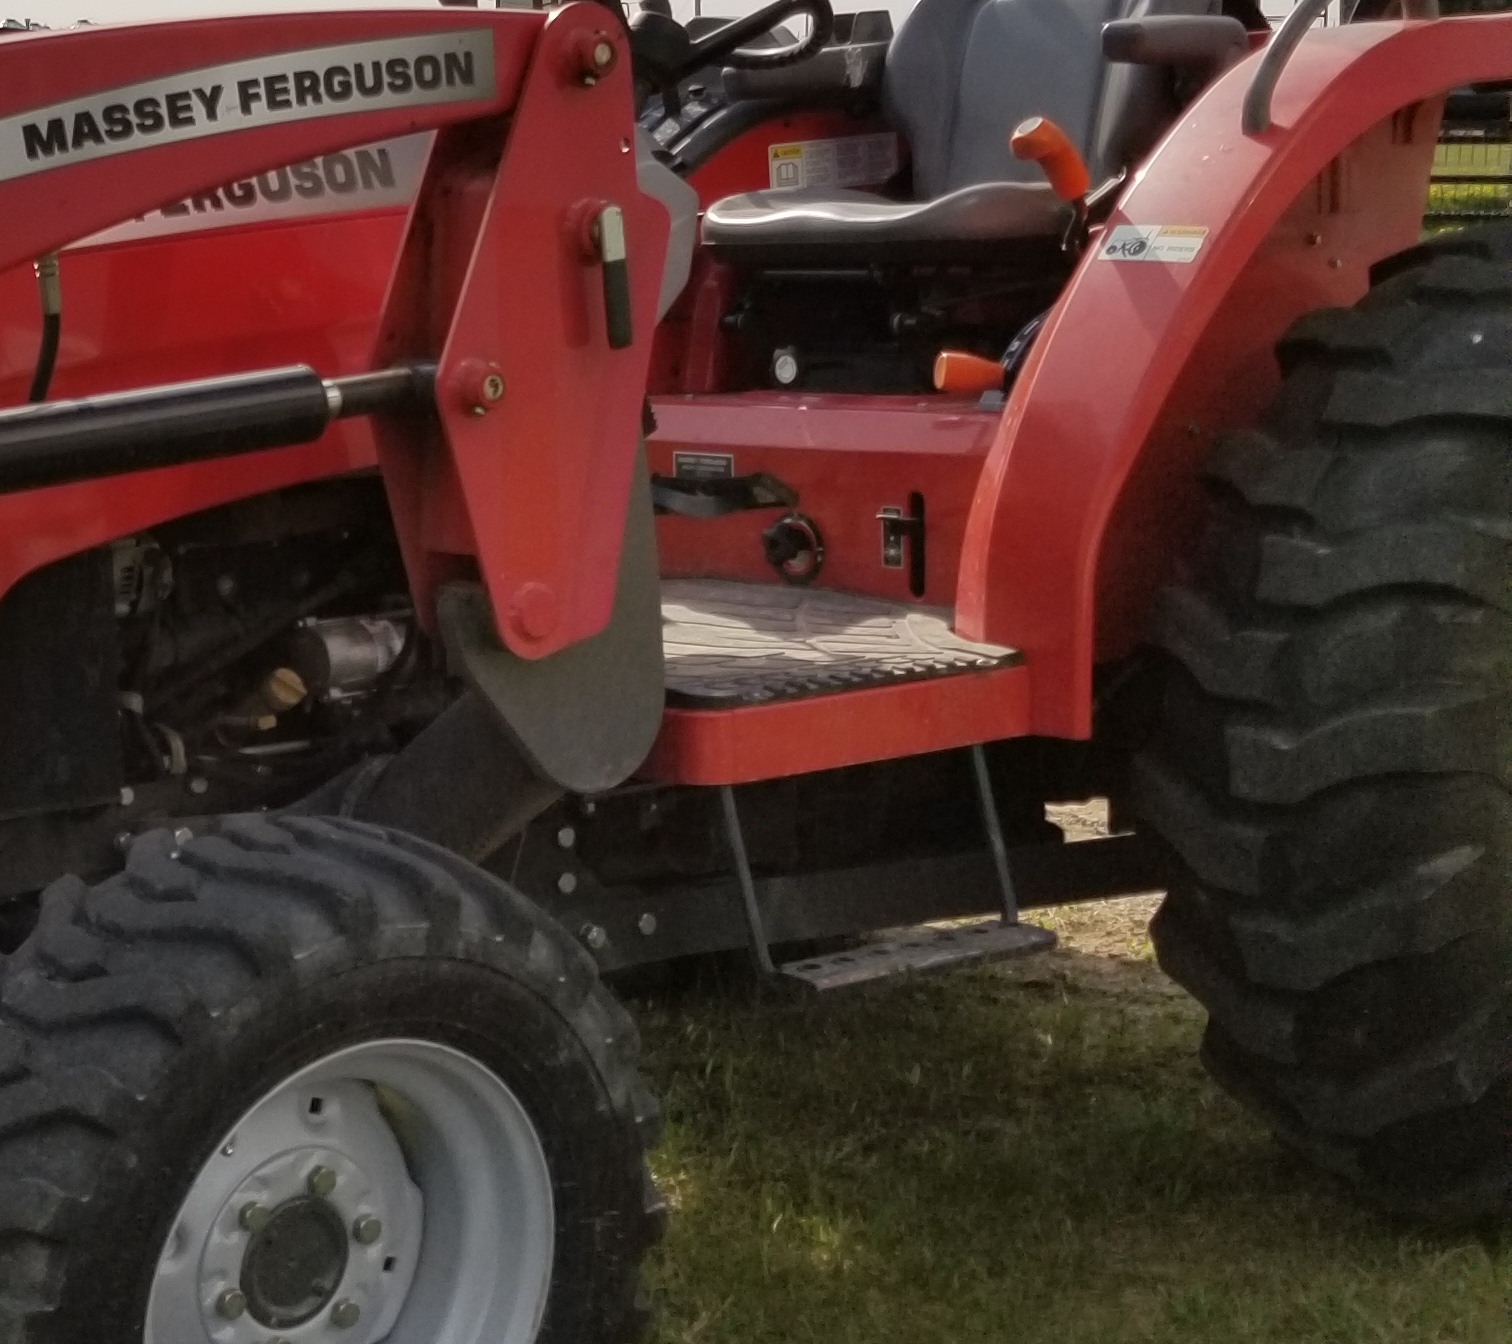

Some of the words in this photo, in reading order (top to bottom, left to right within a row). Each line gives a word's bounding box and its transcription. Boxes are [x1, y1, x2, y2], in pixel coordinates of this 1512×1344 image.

[21, 83, 224, 161] MASSEY
[236, 50, 475, 117] FERGUSON
[134, 147, 397, 223] GUSON
